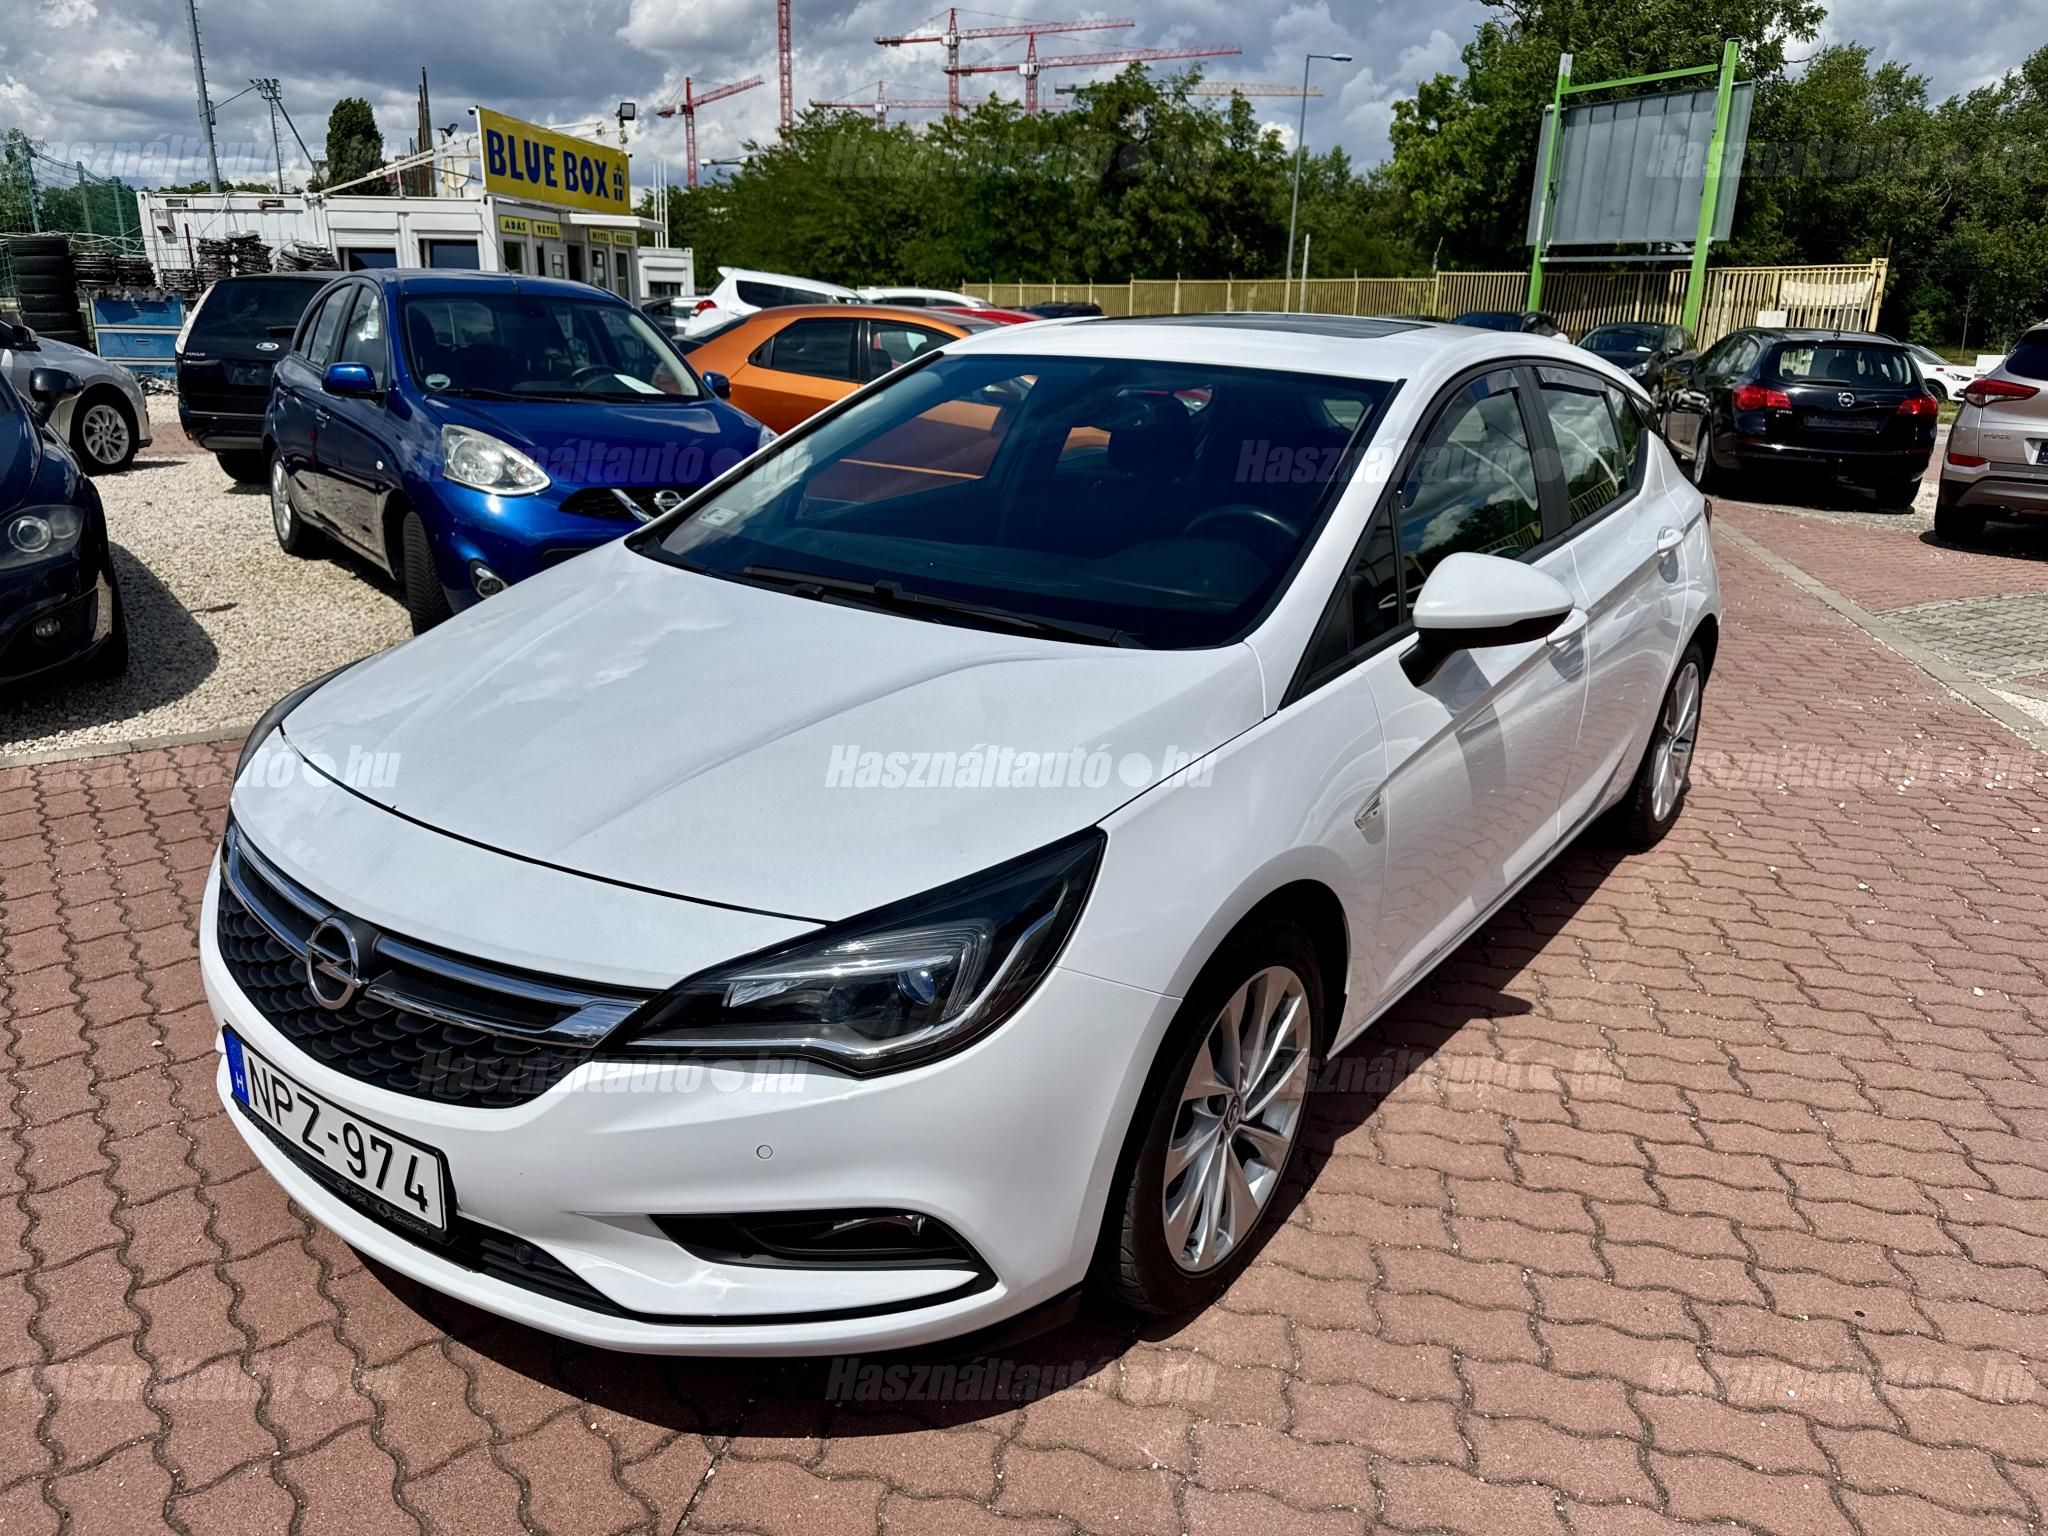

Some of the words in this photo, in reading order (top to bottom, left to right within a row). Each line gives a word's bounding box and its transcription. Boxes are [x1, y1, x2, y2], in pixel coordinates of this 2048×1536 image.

[486, 129, 558, 188] BLUE
[563, 151, 609, 198] BOX
[235, 1074, 245, 1092] H
[247, 1056, 429, 1213] NPZ-974
